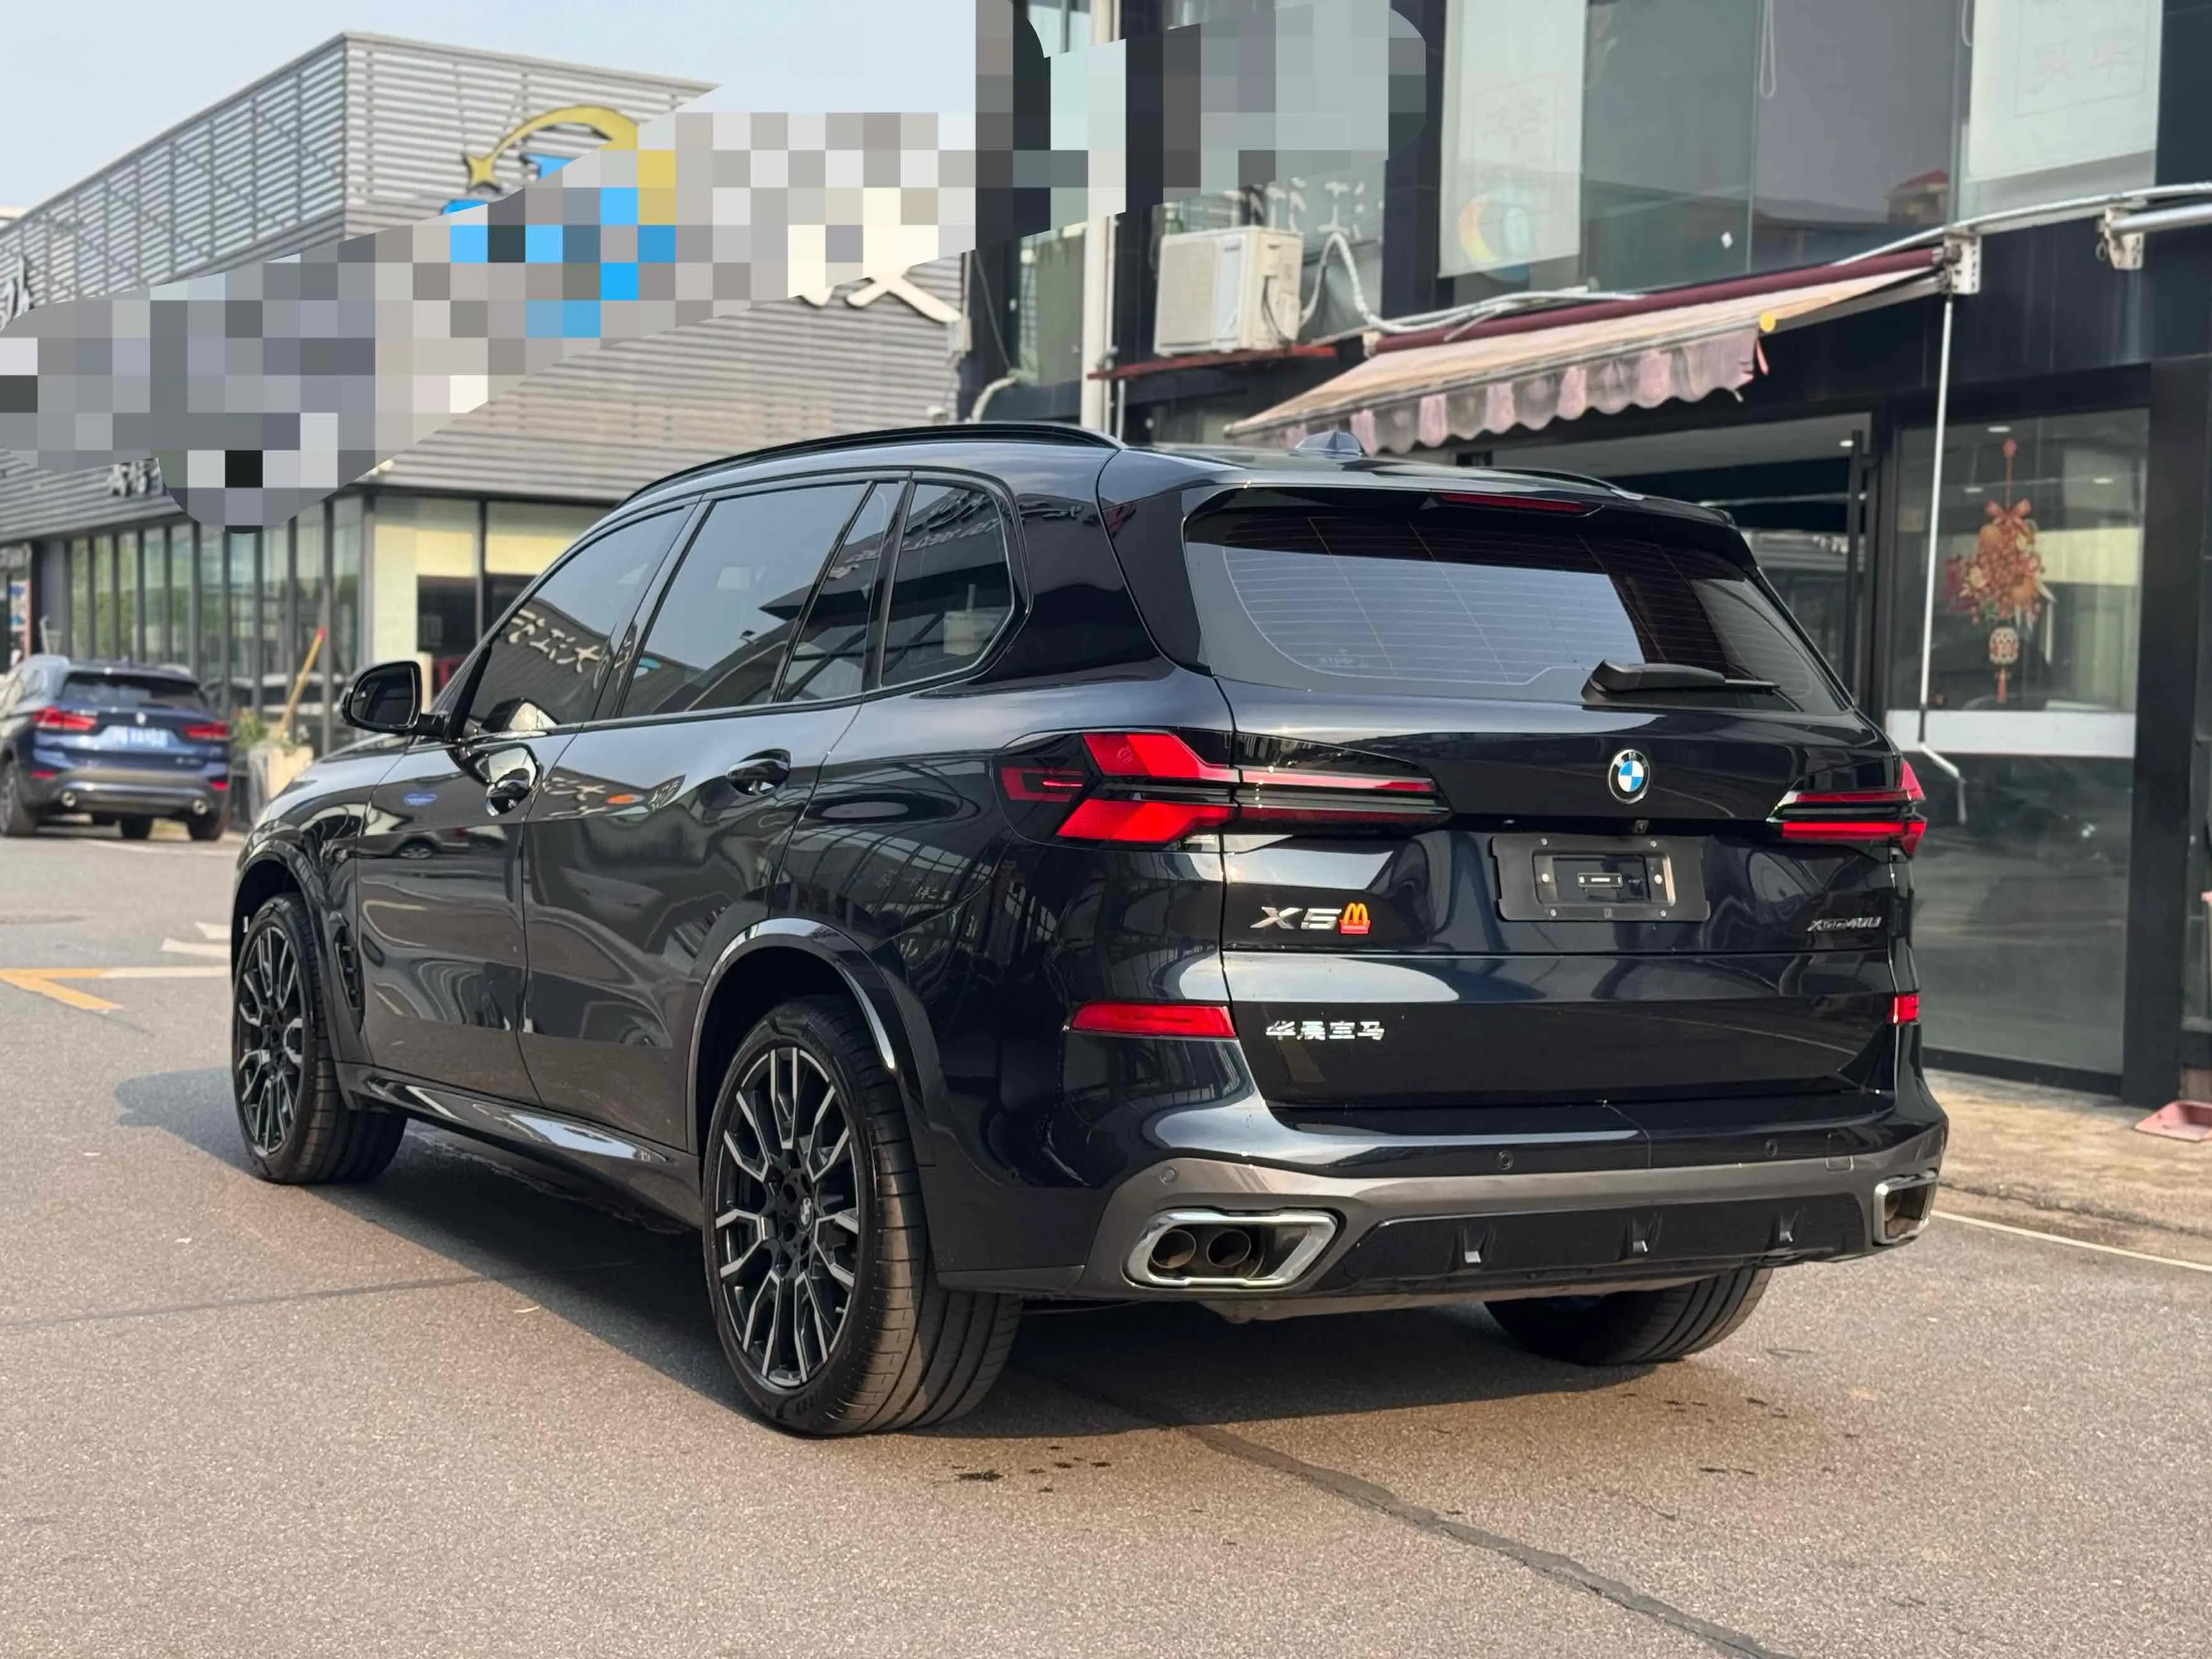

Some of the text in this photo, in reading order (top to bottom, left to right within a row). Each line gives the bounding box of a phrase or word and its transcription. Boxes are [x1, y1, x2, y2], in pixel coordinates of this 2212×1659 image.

[1250, 906, 1342, 930] X5
[1265, 1020, 1385, 1041] 华晨宝马
